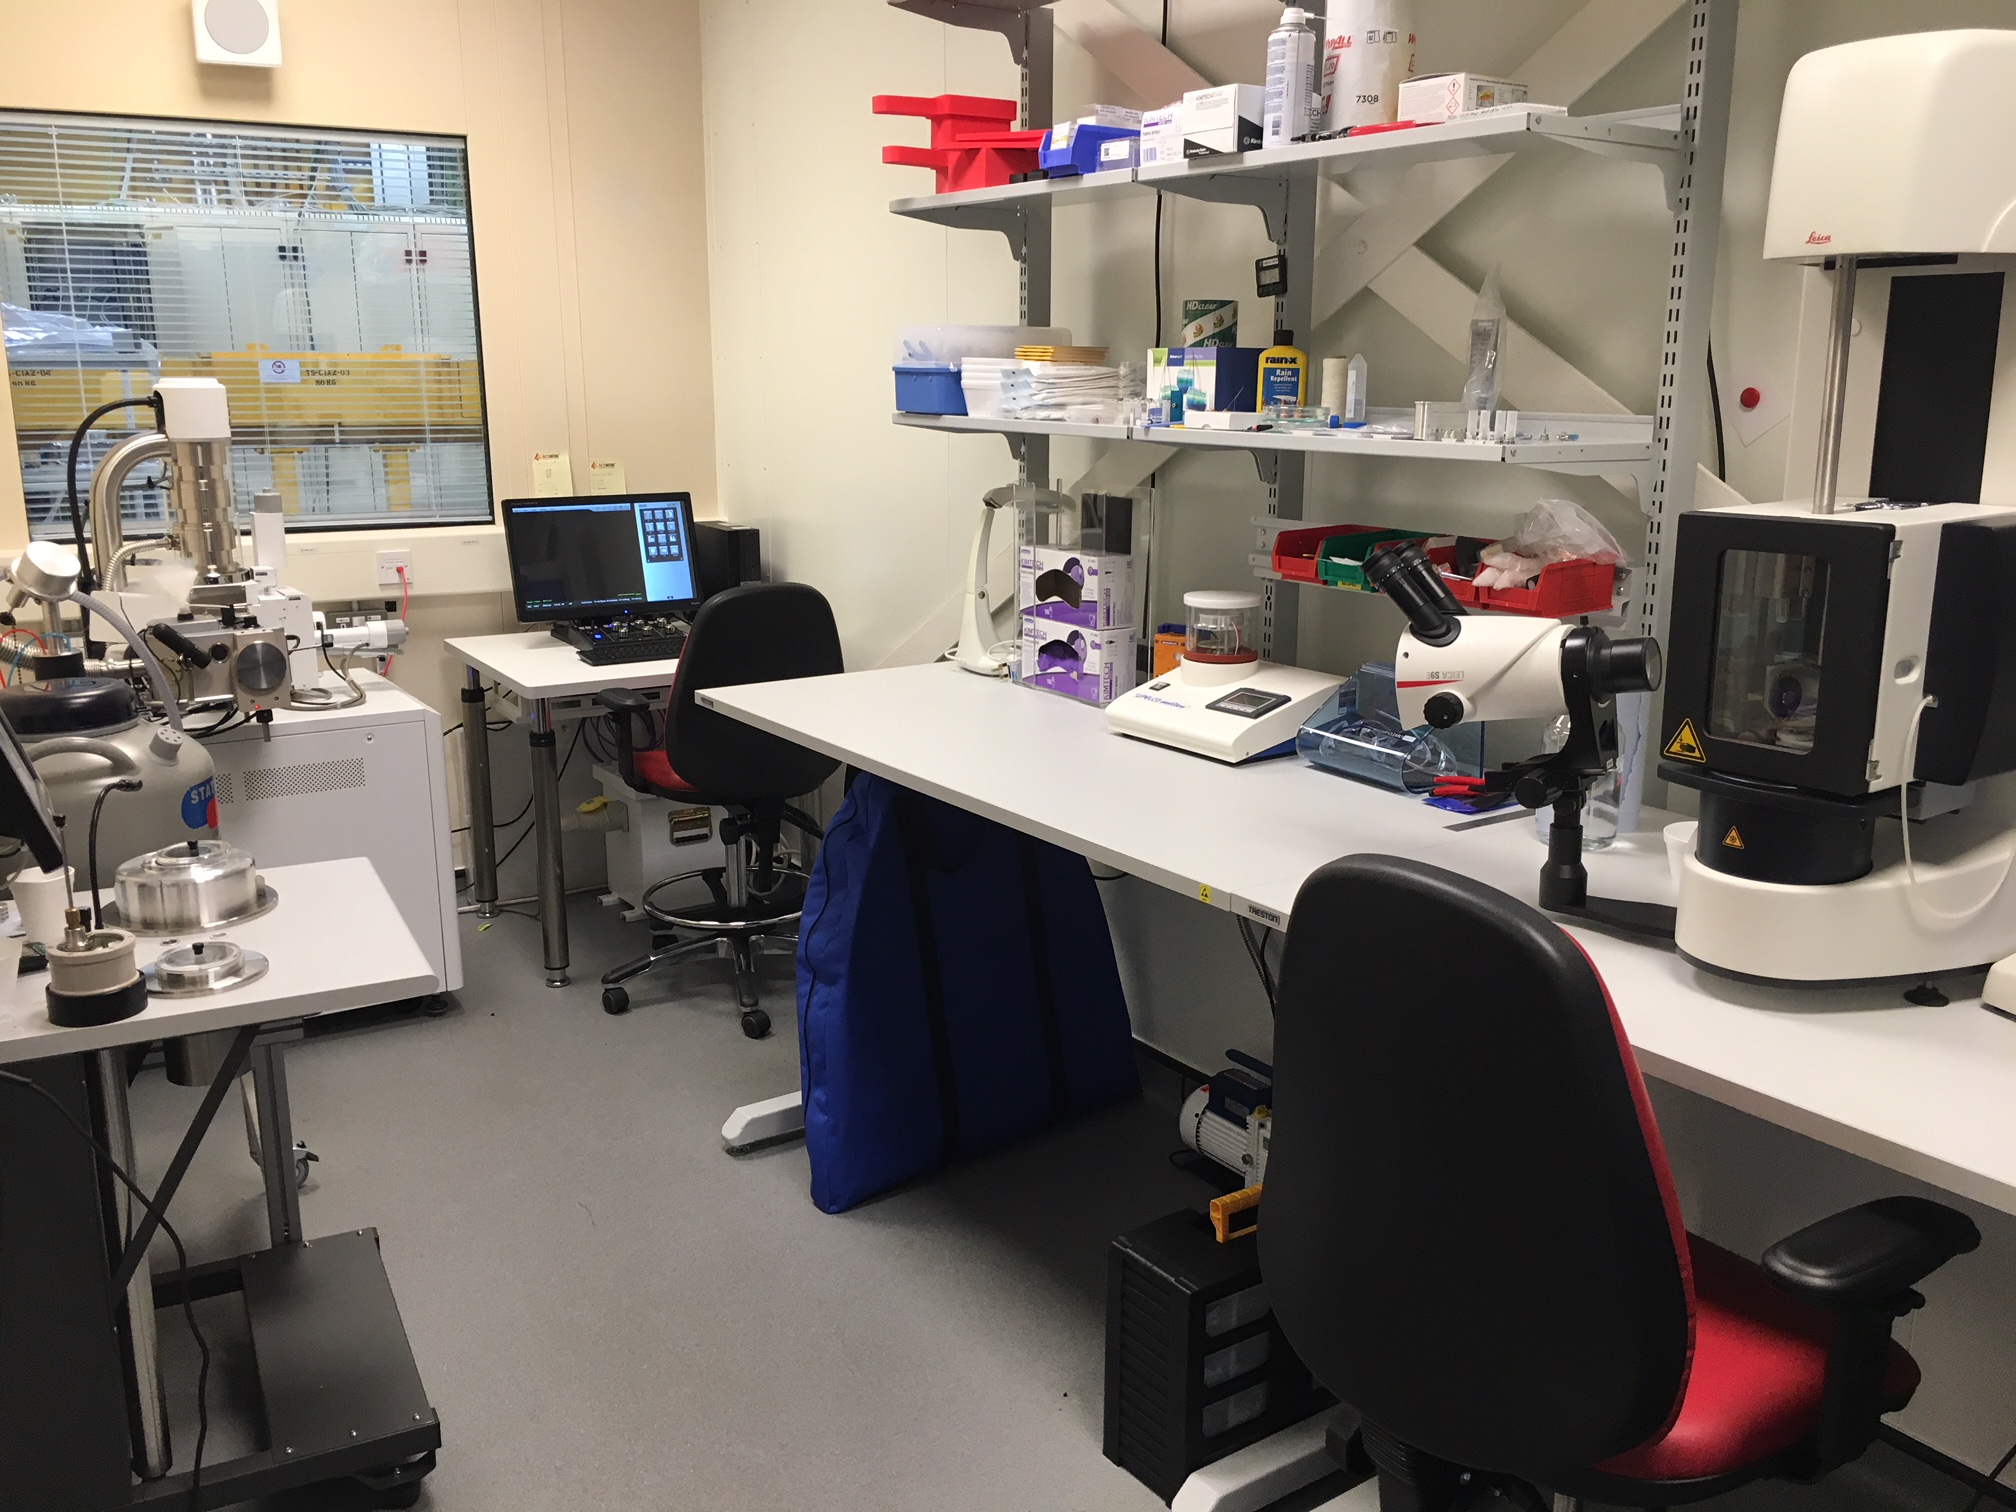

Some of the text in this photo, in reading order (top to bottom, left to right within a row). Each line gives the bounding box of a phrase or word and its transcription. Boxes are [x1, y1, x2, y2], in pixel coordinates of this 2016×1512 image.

[1356, 95, 1379, 103] 7308
[1805, 231, 1831, 244] Leica
[1187, 301, 1198, 310] HD
[1204, 339, 1219, 347] HD
[1248, 905, 1278, 923] TRESTON
